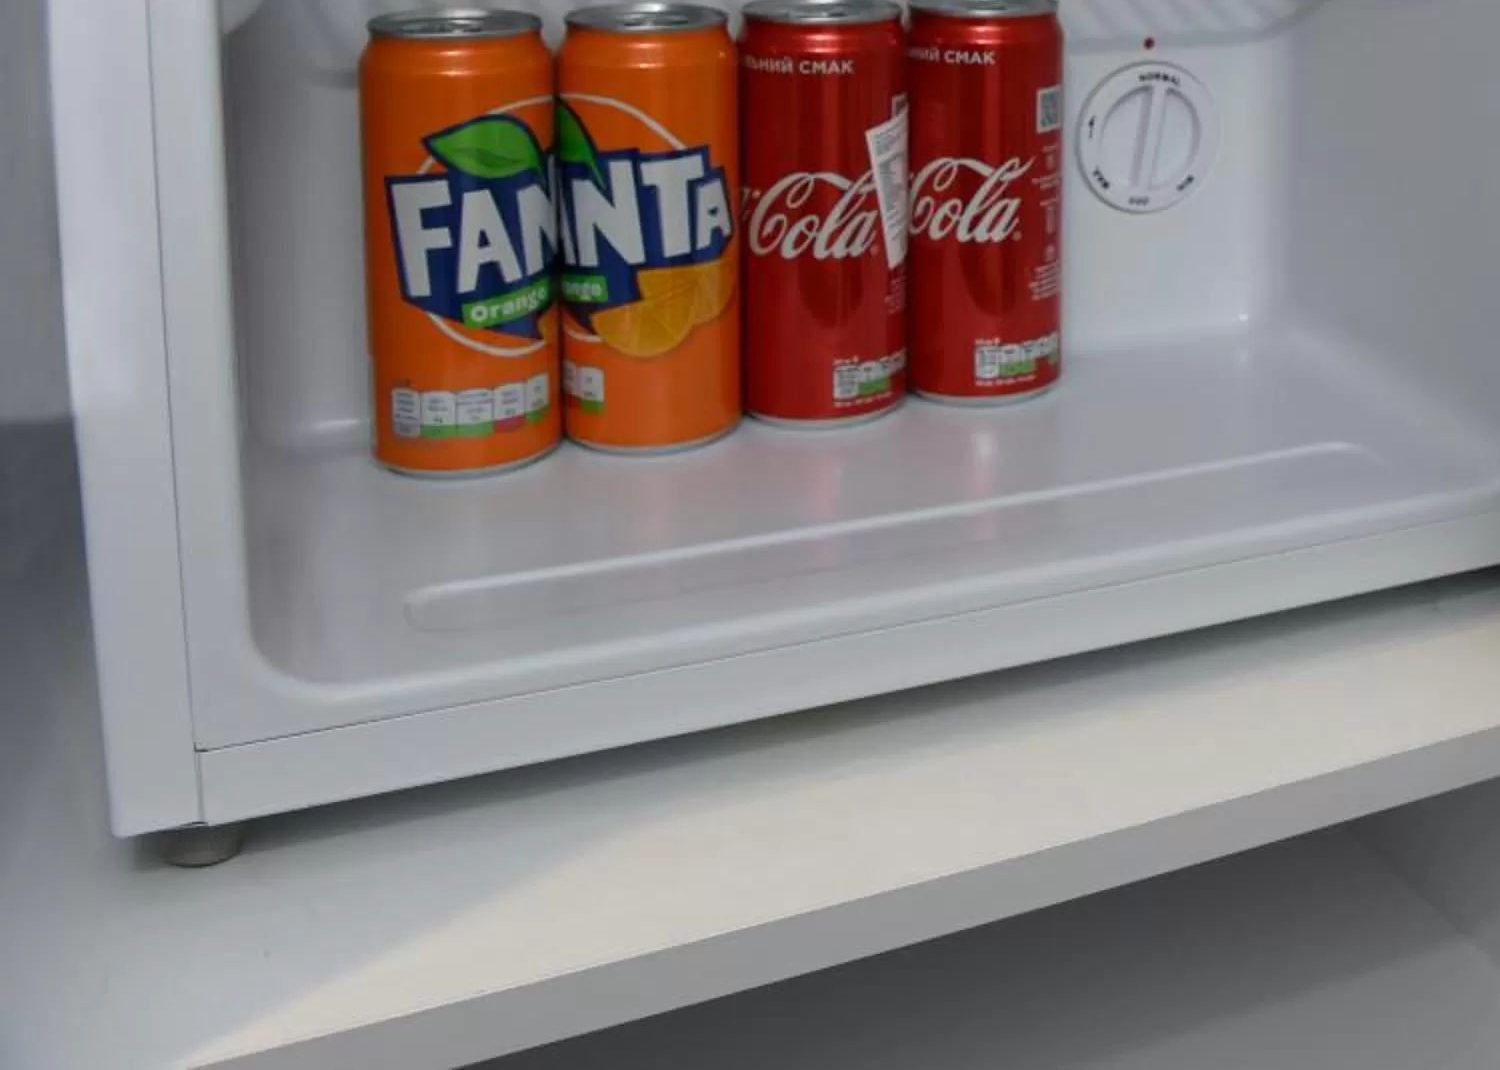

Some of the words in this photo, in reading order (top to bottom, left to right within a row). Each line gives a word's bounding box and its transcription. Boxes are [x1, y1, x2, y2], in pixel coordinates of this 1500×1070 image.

[561, 154, 732, 267] NTA
[750, 168, 880, 260] Cola
[908, 156, 1036, 243] Cola
